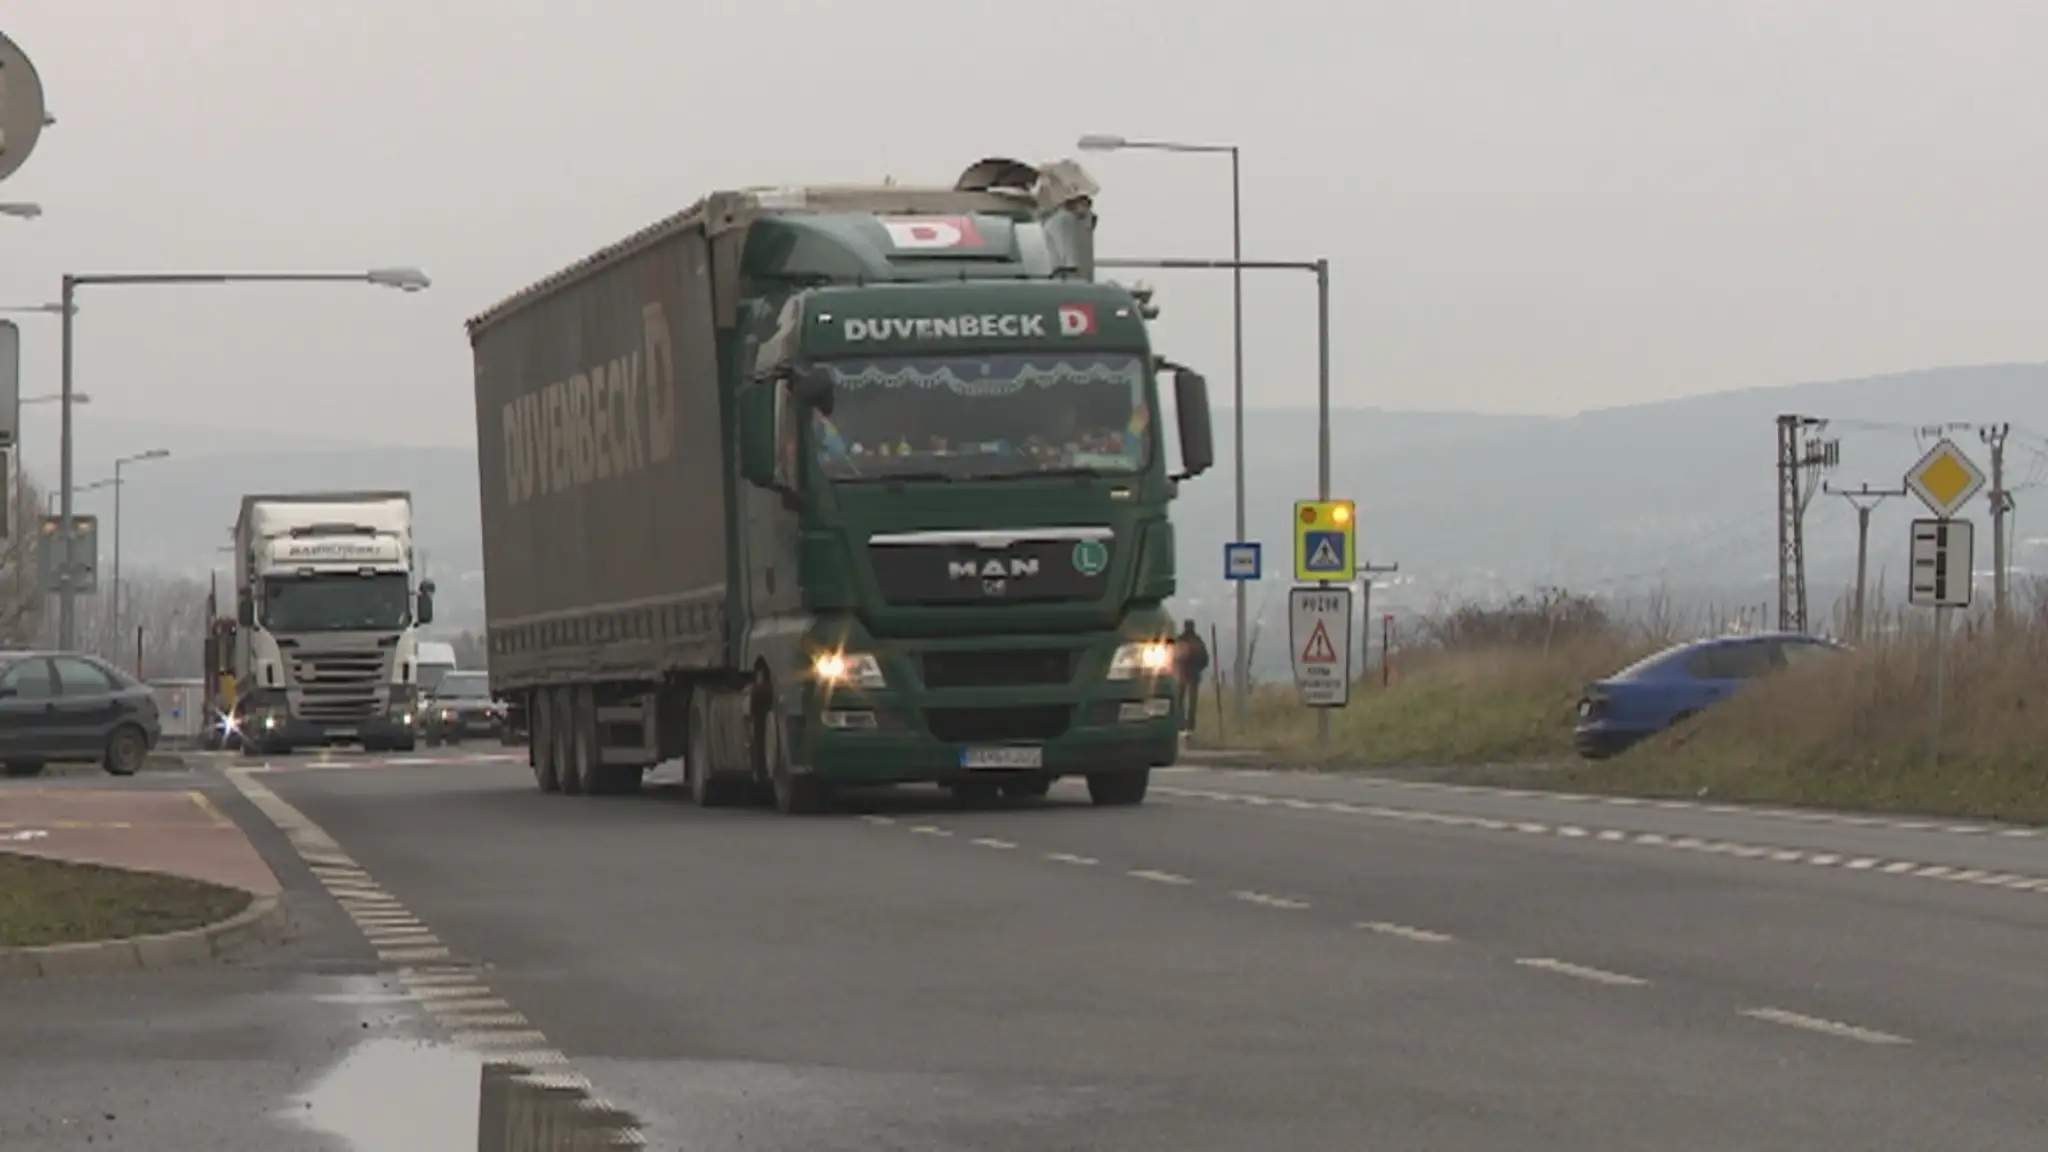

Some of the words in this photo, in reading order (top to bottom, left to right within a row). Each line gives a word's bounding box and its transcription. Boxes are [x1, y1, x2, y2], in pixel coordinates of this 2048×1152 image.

[883, 218, 962, 248] D
[843, 313, 1046, 342] DUVENBECK
[1059, 307, 1090, 336] D
[503, 350, 643, 507] DUVENBECK
[642, 302, 674, 462] D
[949, 558, 1040, 580] MAN
